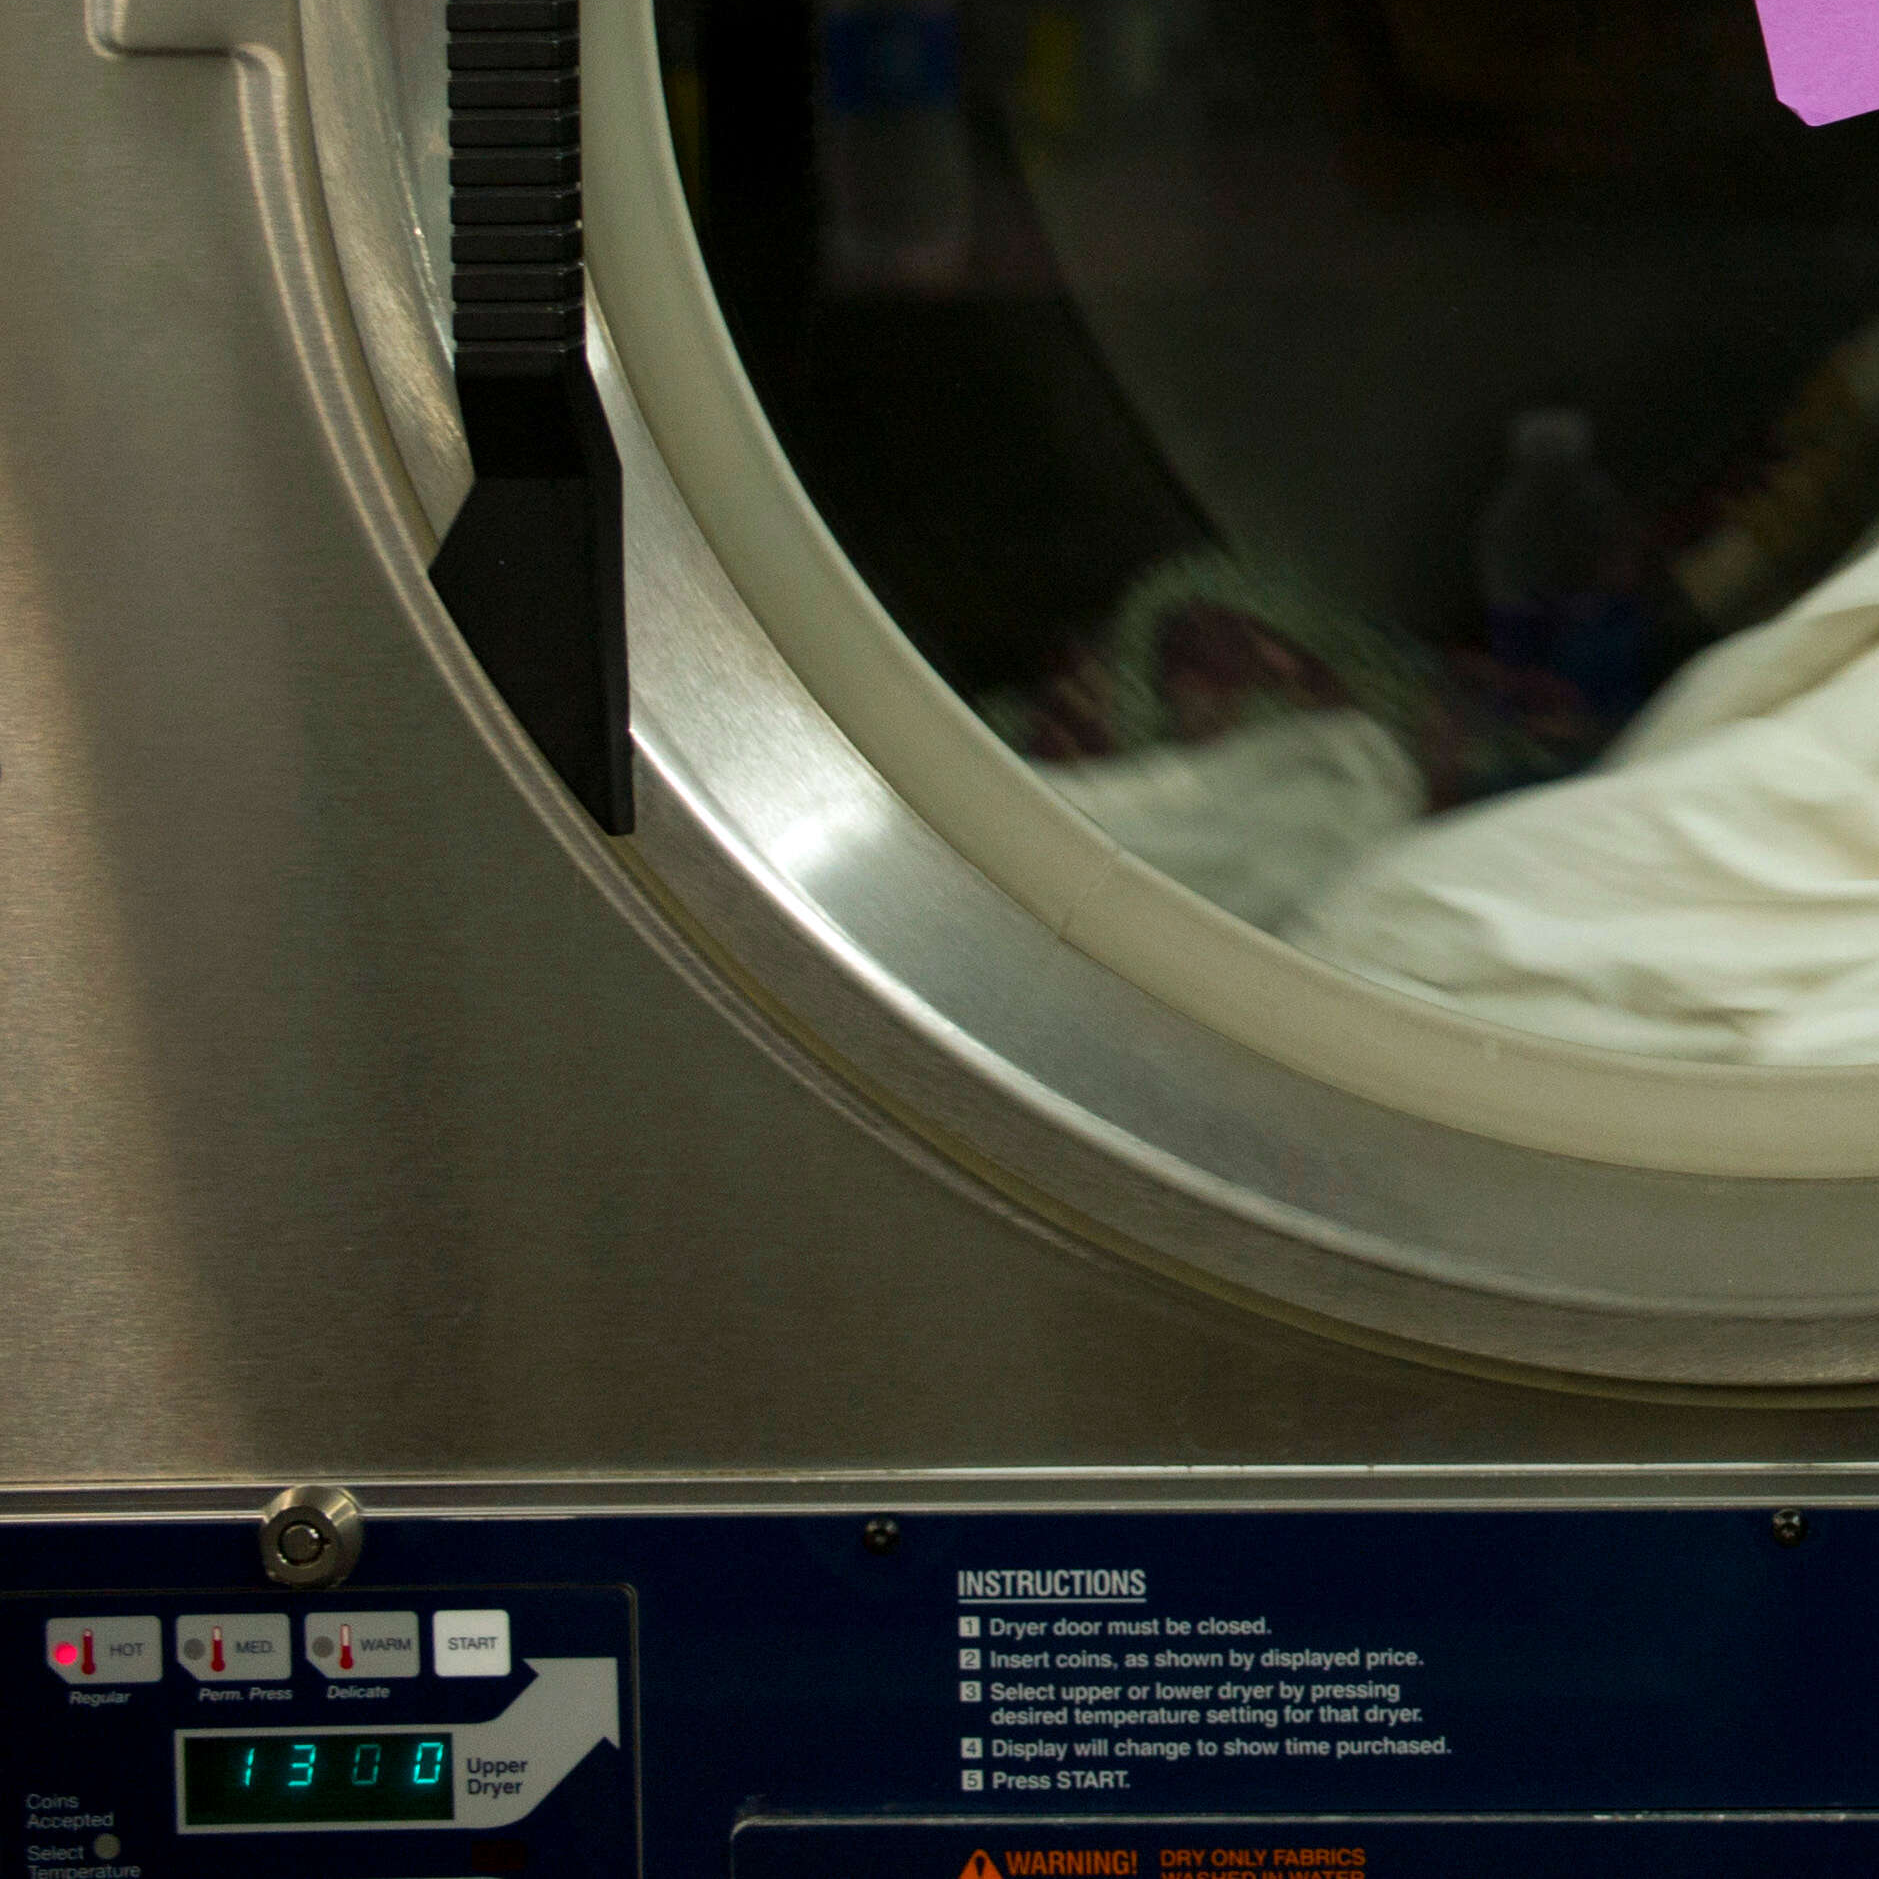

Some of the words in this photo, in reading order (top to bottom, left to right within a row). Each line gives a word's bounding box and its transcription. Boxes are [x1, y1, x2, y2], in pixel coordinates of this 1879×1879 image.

[957, 1568, 1147, 1598] INSTRUCTIONS
[989, 1617, 1047, 1640] Dryer
[1053, 1618, 1103, 1637] door
[1107, 1618, 1160, 1636] must
[1165, 1616, 1192, 1636] be
[1196, 1616, 1273, 1636] closed.
[109, 1642, 145, 1658] HOT
[235, 1639, 276, 1655] MED.
[359, 1637, 412, 1652] WARM
[447, 1636, 498, 1651] START
[989, 1650, 1051, 1669] Insert
[1055, 1649, 1119, 1672] coins,
[1123, 1653, 1150, 1668] as
[1154, 1648, 1224, 1668] shown
[1229, 1648, 1255, 1672] by
[1259, 1647, 1361, 1672] displayed
[1366, 1647, 1425, 1672] price.
[68, 1690, 131, 1707] Regular
[197, 1687, 245, 1702] Perm.
[248, 1686, 293, 1701] Press
[325, 1684, 391, 1700] Delicate
[990, 1681, 1056, 1701] Select
[1061, 1685, 1123, 1705] upper
[1127, 1685, 1151, 1701] or
[1155, 1681, 1214, 1700] lower
[1217, 1681, 1275, 1704] dryer
[1279, 1680, 1305, 1704] by
[1310, 1679, 1401, 1704] pressing
[990, 1706, 1068, 1726] desired
[1073, 1707, 1201, 1729] temperature
[1205, 1705, 1279, 1728] setting
[1283, 1704, 1314, 1724] for
[1318, 1704, 1360, 1724] that
[1364, 1704, 1423, 1727] dryer.
[991, 1738, 1069, 1762] Display
[1073, 1738, 1109, 1757] will
[1113, 1738, 1192, 1761] change
[1196, 1738, 1219, 1757] to
[1223, 1737, 1280, 1756] show
[1284, 1737, 1332, 1756] time
[1336, 1735, 1452, 1760] purchased.
[466, 1757, 529, 1779] Upper
[466, 1777, 524, 1800] Dryer
[992, 1771, 1052, 1790] Press
[1056, 1770, 1131, 1790] START.
[25, 1793, 80, 1809] Coins
[26, 1810, 115, 1830] Accepted
[25, 1845, 85, 1862] Select
[1005, 1850, 1138, 1876] WARNING!
[1160, 1848, 1206, 1868] DRY
[1209, 1848, 1267, 1867] ONLY
[1273, 1848, 1367, 1867] FABRICS
[25, 1864, 143, 1879] Temperature
